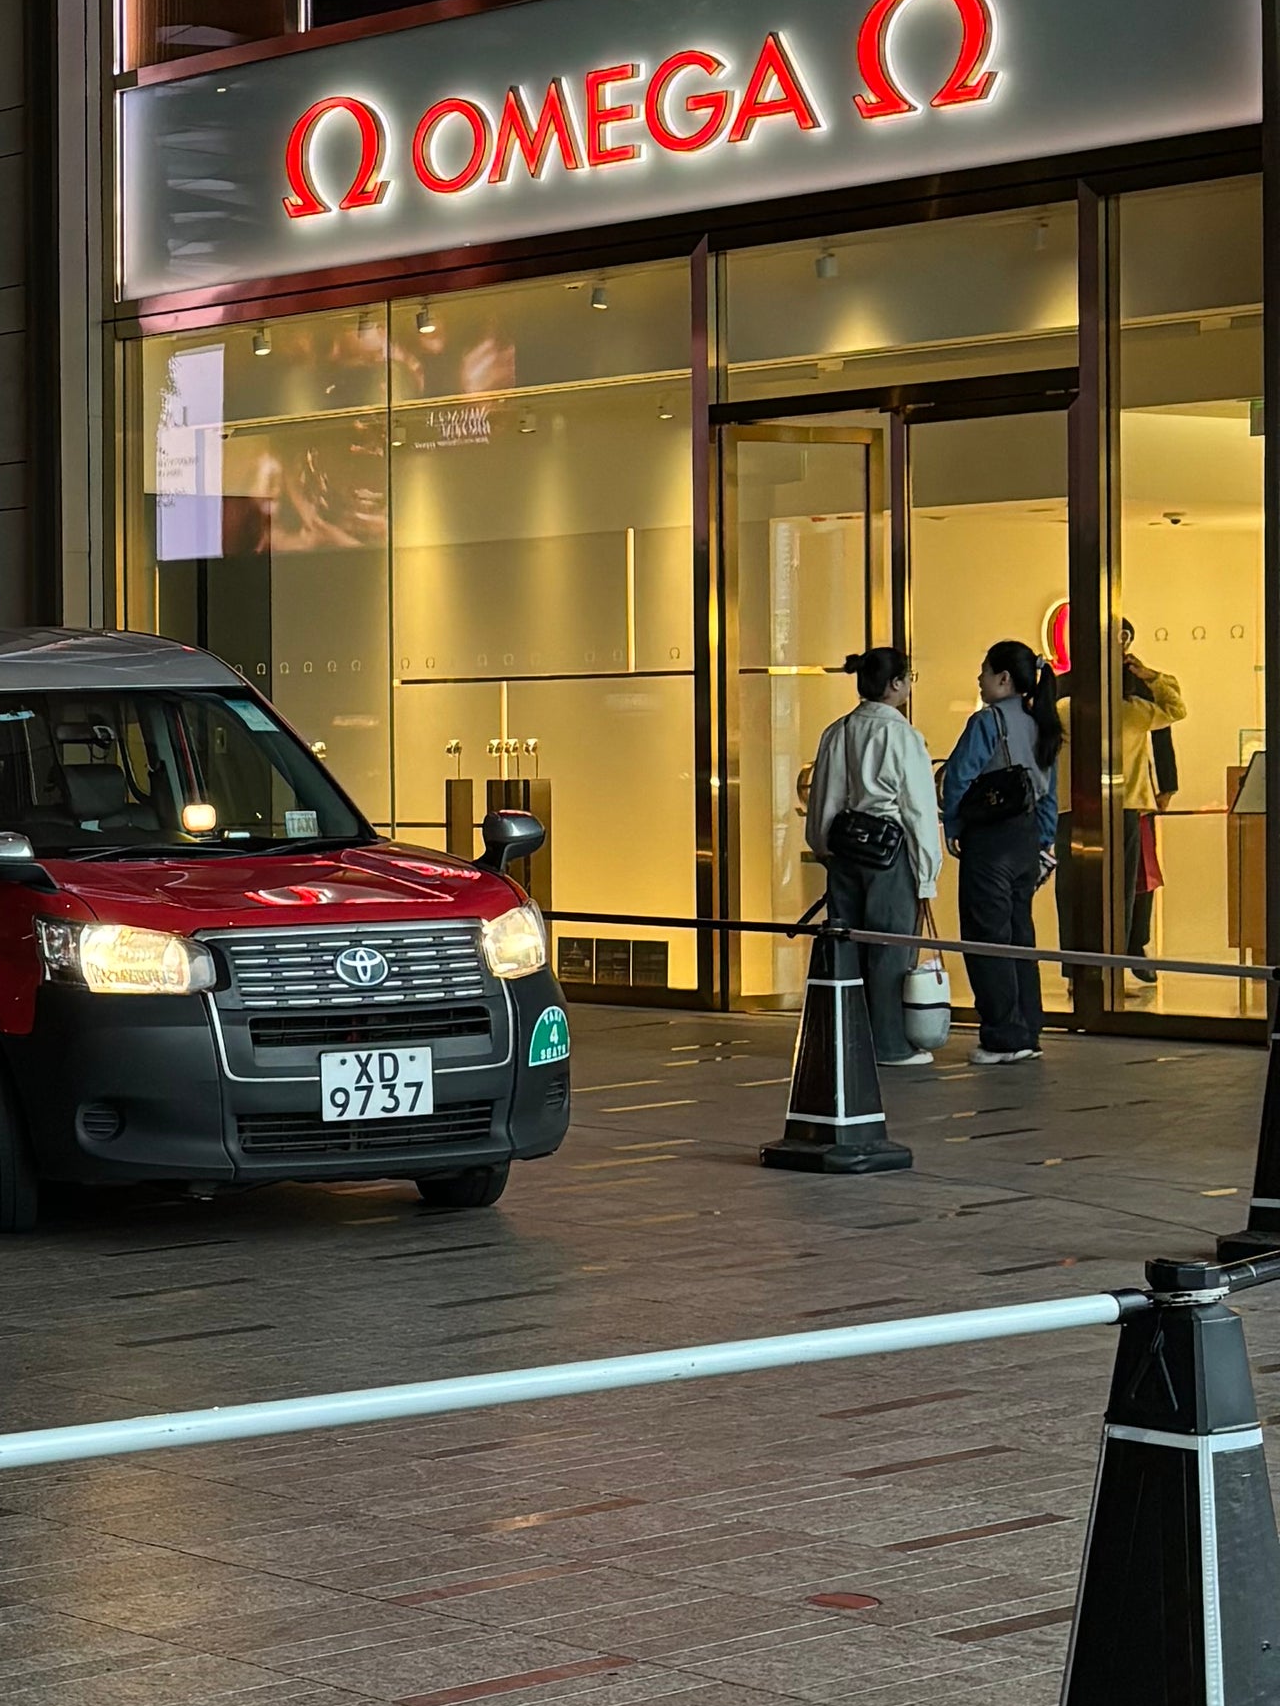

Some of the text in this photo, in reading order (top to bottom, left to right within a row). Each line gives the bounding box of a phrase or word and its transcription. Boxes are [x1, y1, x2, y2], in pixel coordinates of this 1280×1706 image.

[412, 31, 823, 194] OMEGA
[549, 1023, 559, 1045] 4
[354, 1052, 400, 1085] XD
[540, 1044, 566, 1060] SEATS
[329, 1081, 424, 1118] 9737
